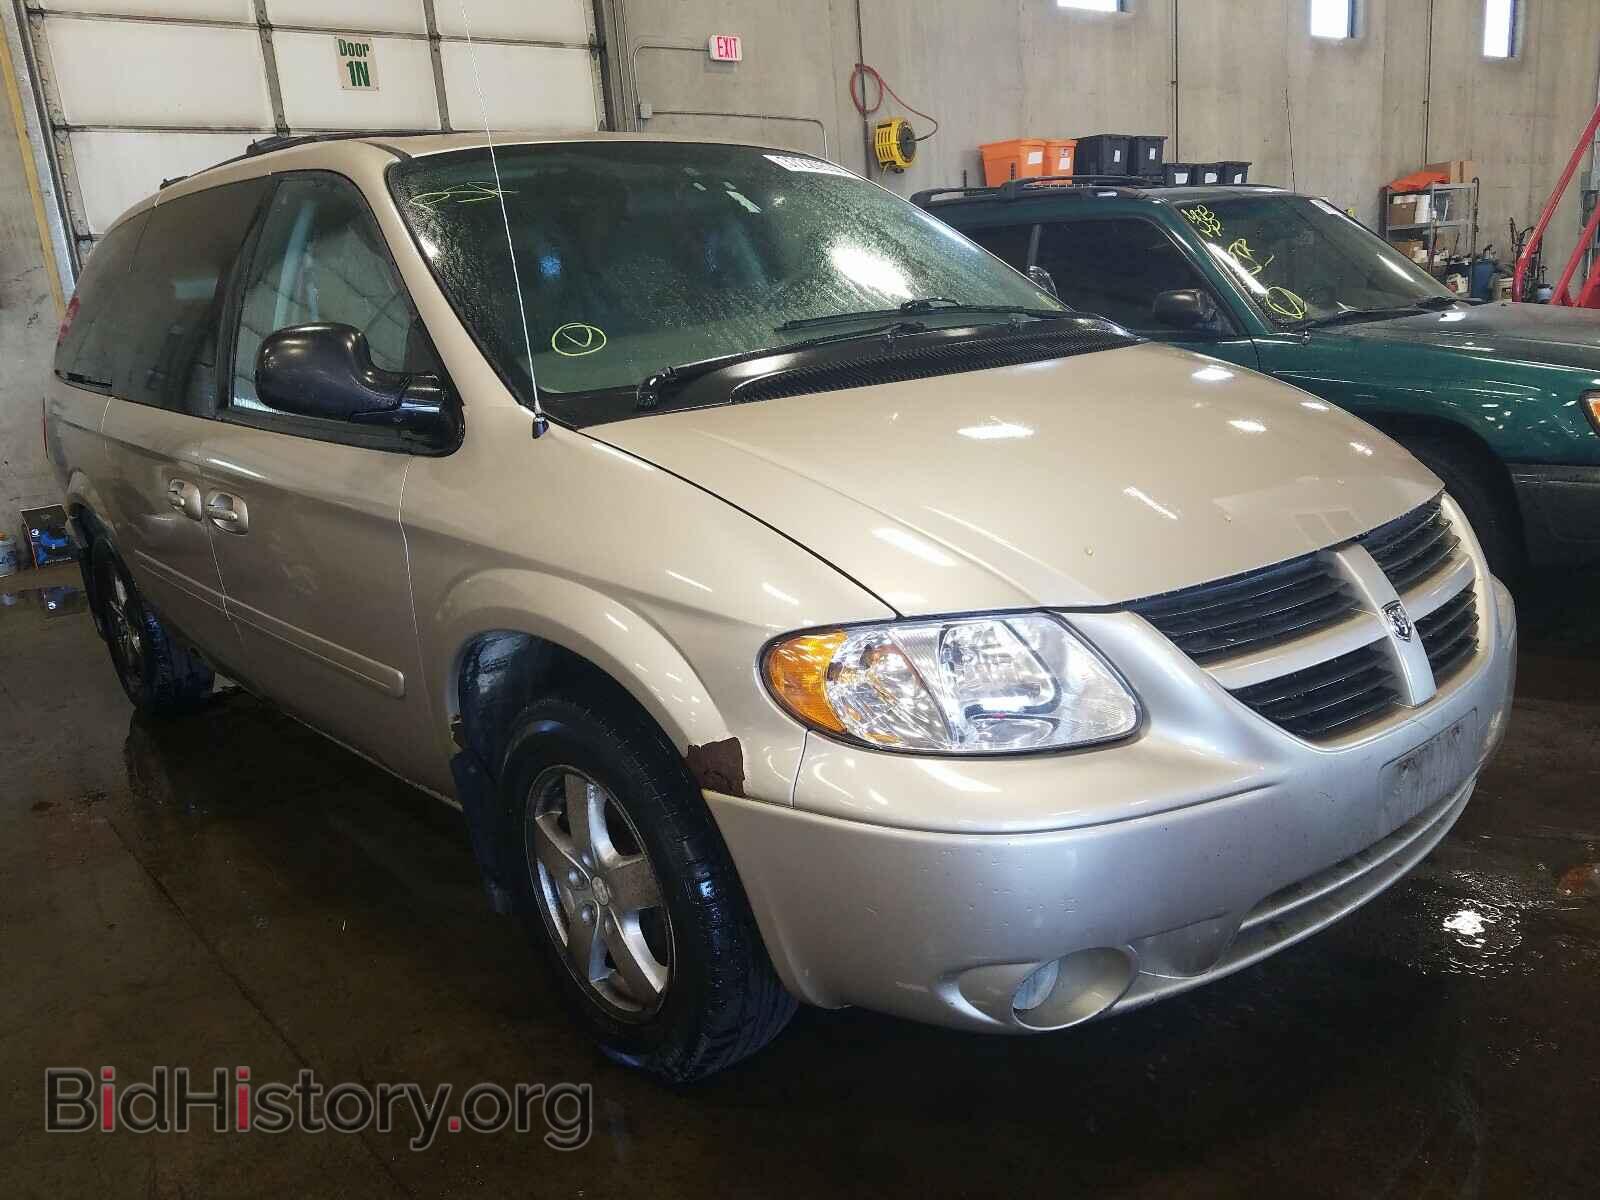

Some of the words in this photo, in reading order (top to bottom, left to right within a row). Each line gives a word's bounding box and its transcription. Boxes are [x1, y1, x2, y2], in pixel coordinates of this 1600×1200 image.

[338, 39, 370, 57] Door
[717, 36, 737, 58] EXIT
[346, 60, 370, 87] 1N
